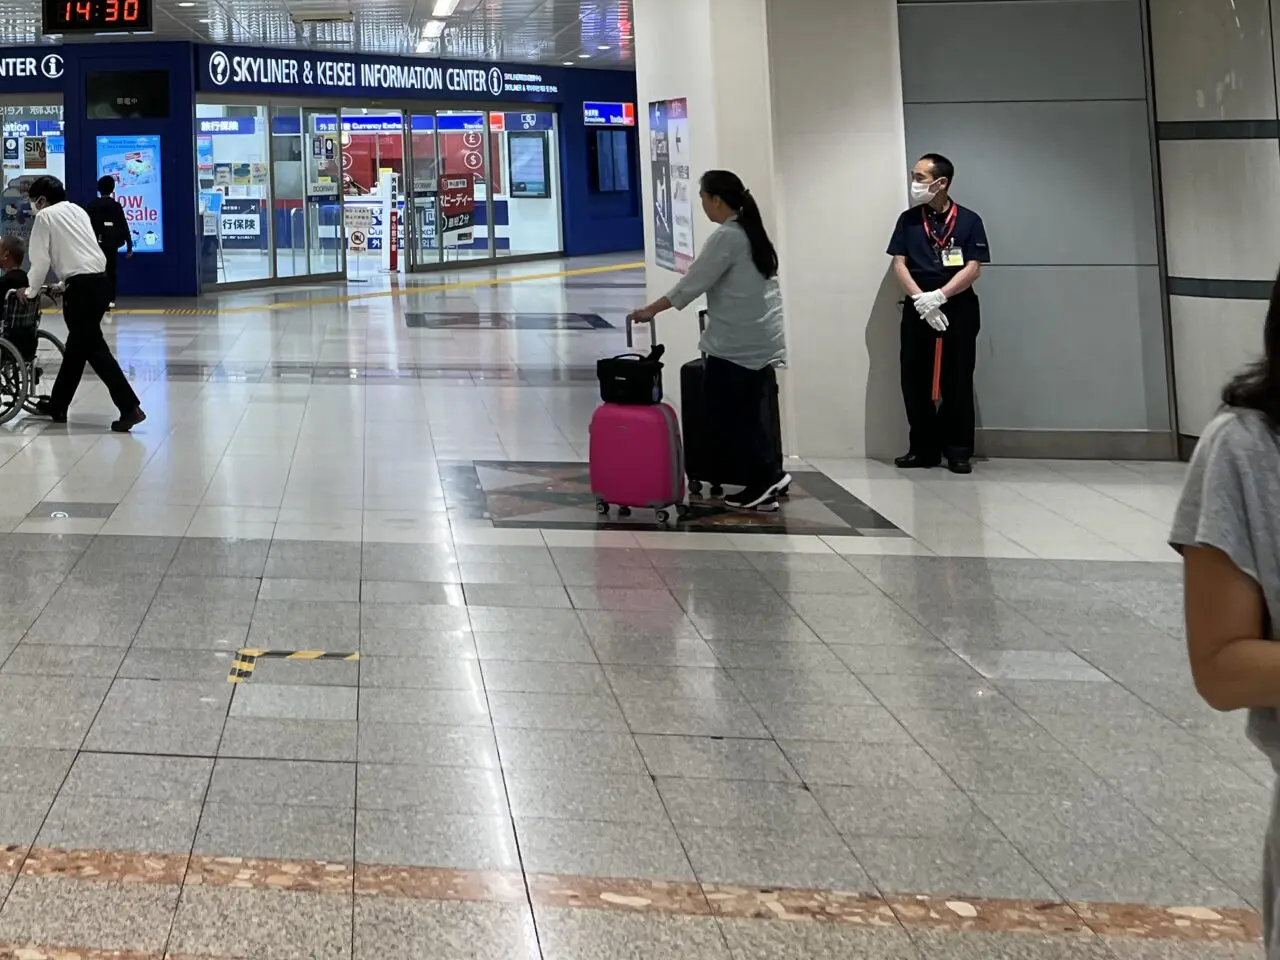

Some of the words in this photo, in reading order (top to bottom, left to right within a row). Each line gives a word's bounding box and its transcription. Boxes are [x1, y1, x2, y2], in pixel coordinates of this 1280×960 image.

[65, 0, 139, 22] 14:30
[233, 56, 299, 84] SKYLINER
[302, 60, 313, 85] &
[317, 61, 356, 87] KEISEI
[361, 63, 442, 90] INFORMATION
[446, 68, 487, 92] CENTER
[25, 141, 46, 152] SIM
[126, 206, 158, 221] sale
